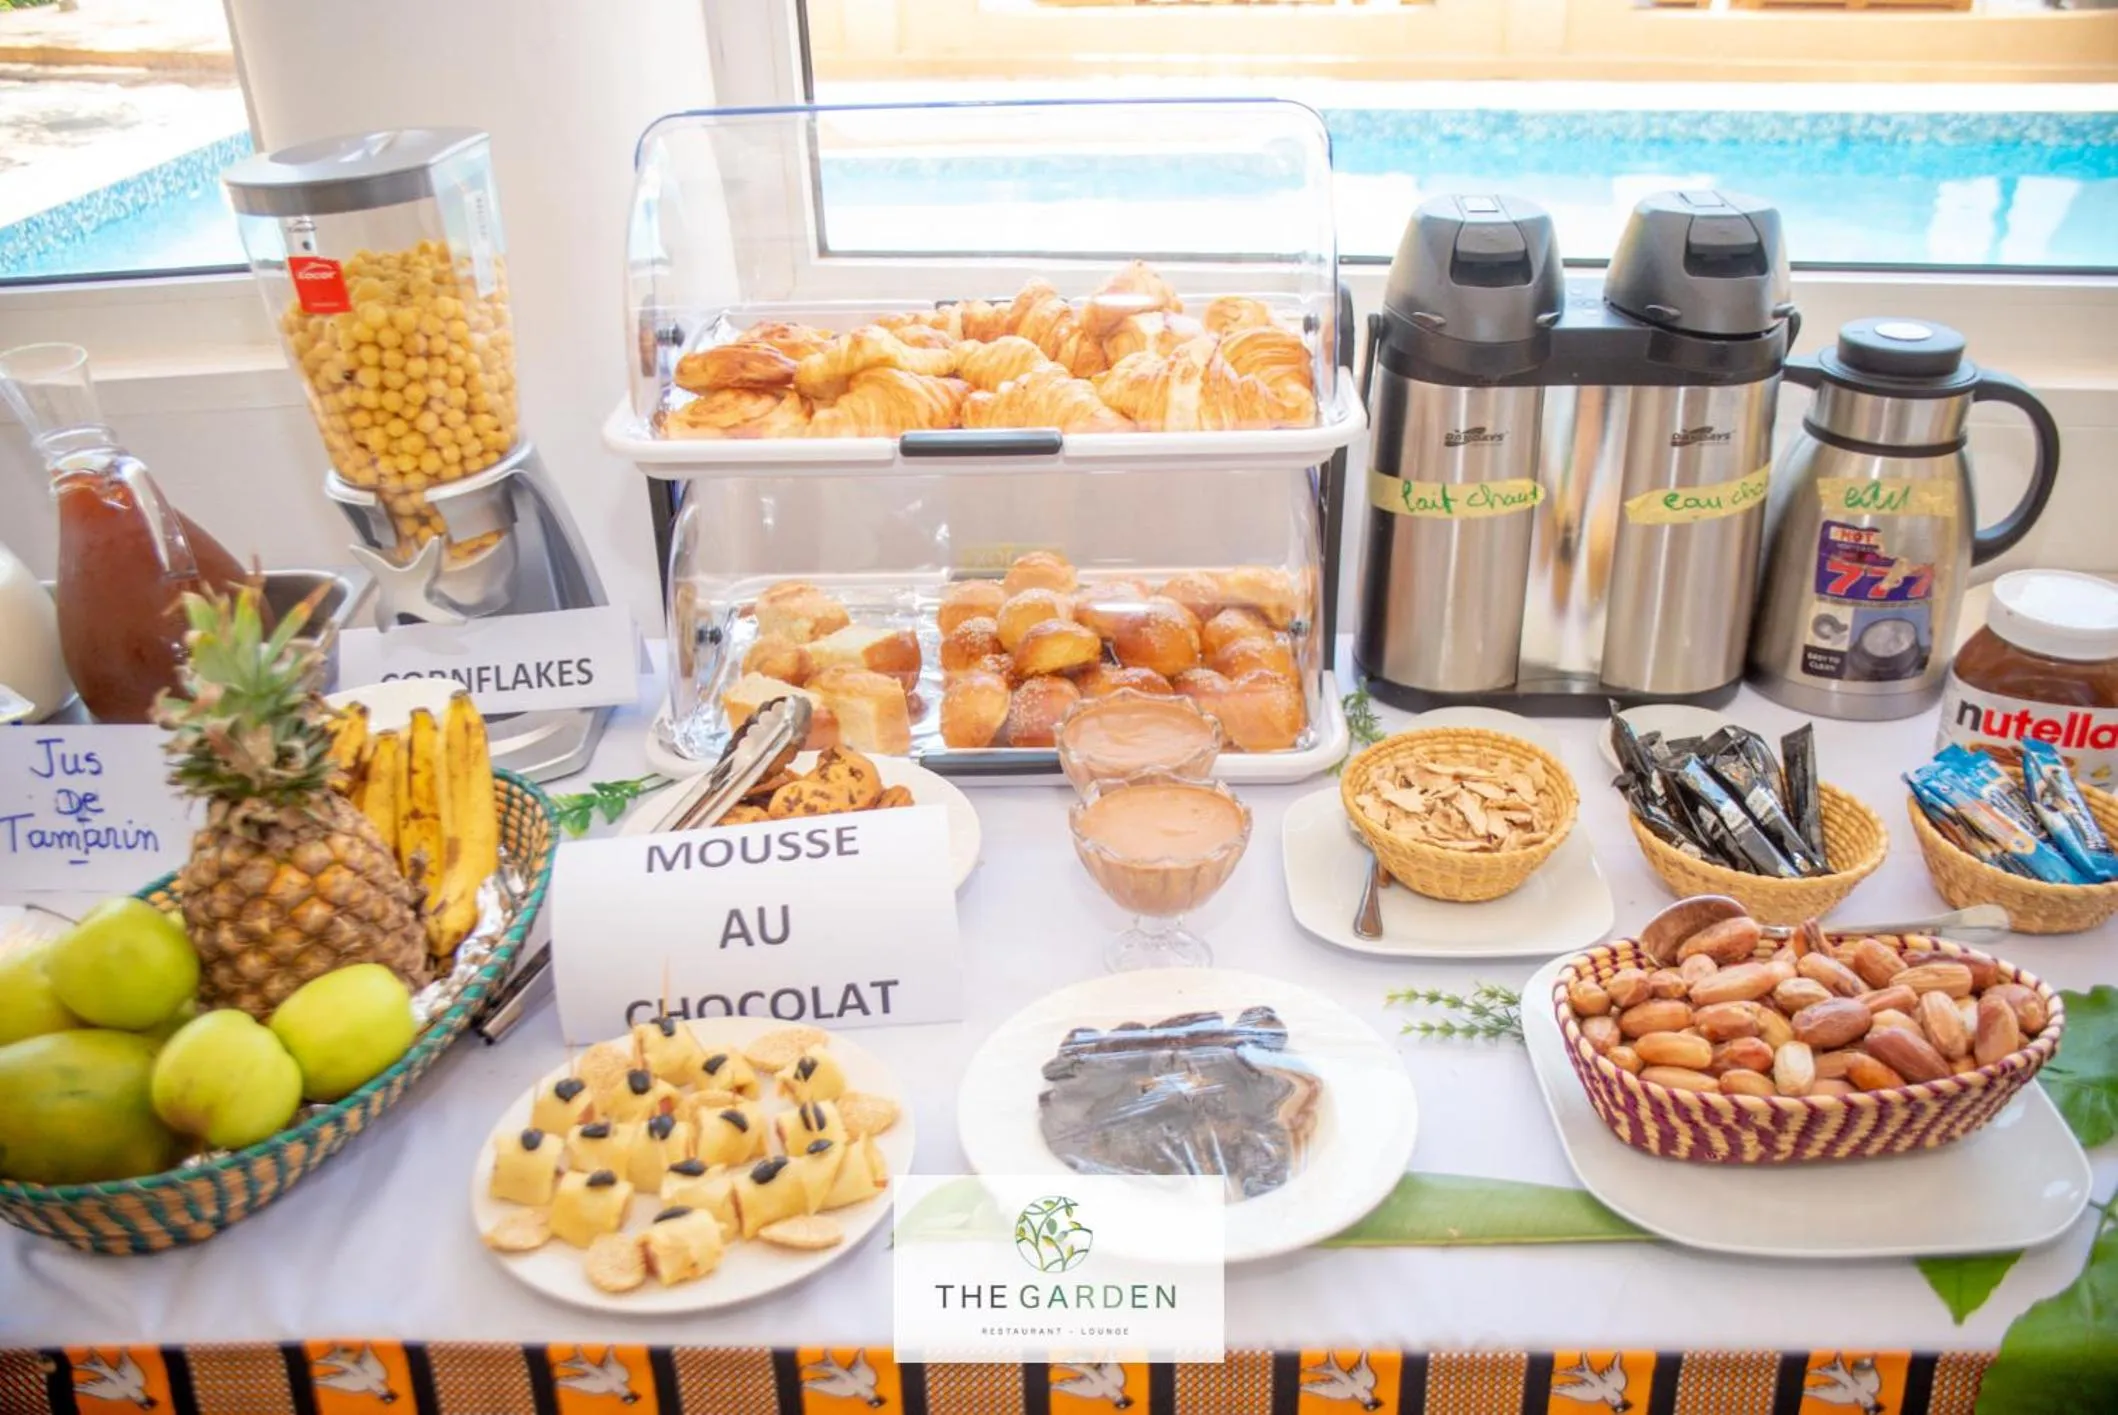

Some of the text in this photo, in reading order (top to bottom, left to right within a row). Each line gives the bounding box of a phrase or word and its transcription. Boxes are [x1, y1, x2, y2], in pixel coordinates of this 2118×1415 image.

[1401, 480, 1458, 513] lait
[1663, 493, 1723, 511] eau
[1844, 481, 1911, 511] eau
[1956, 699, 2118, 749] nutella
[30, 738, 103, 778] Jus
[56, 788, 104, 815] De
[646, 825, 860, 873] MOUSSE
[719, 904, 791, 949] AU
